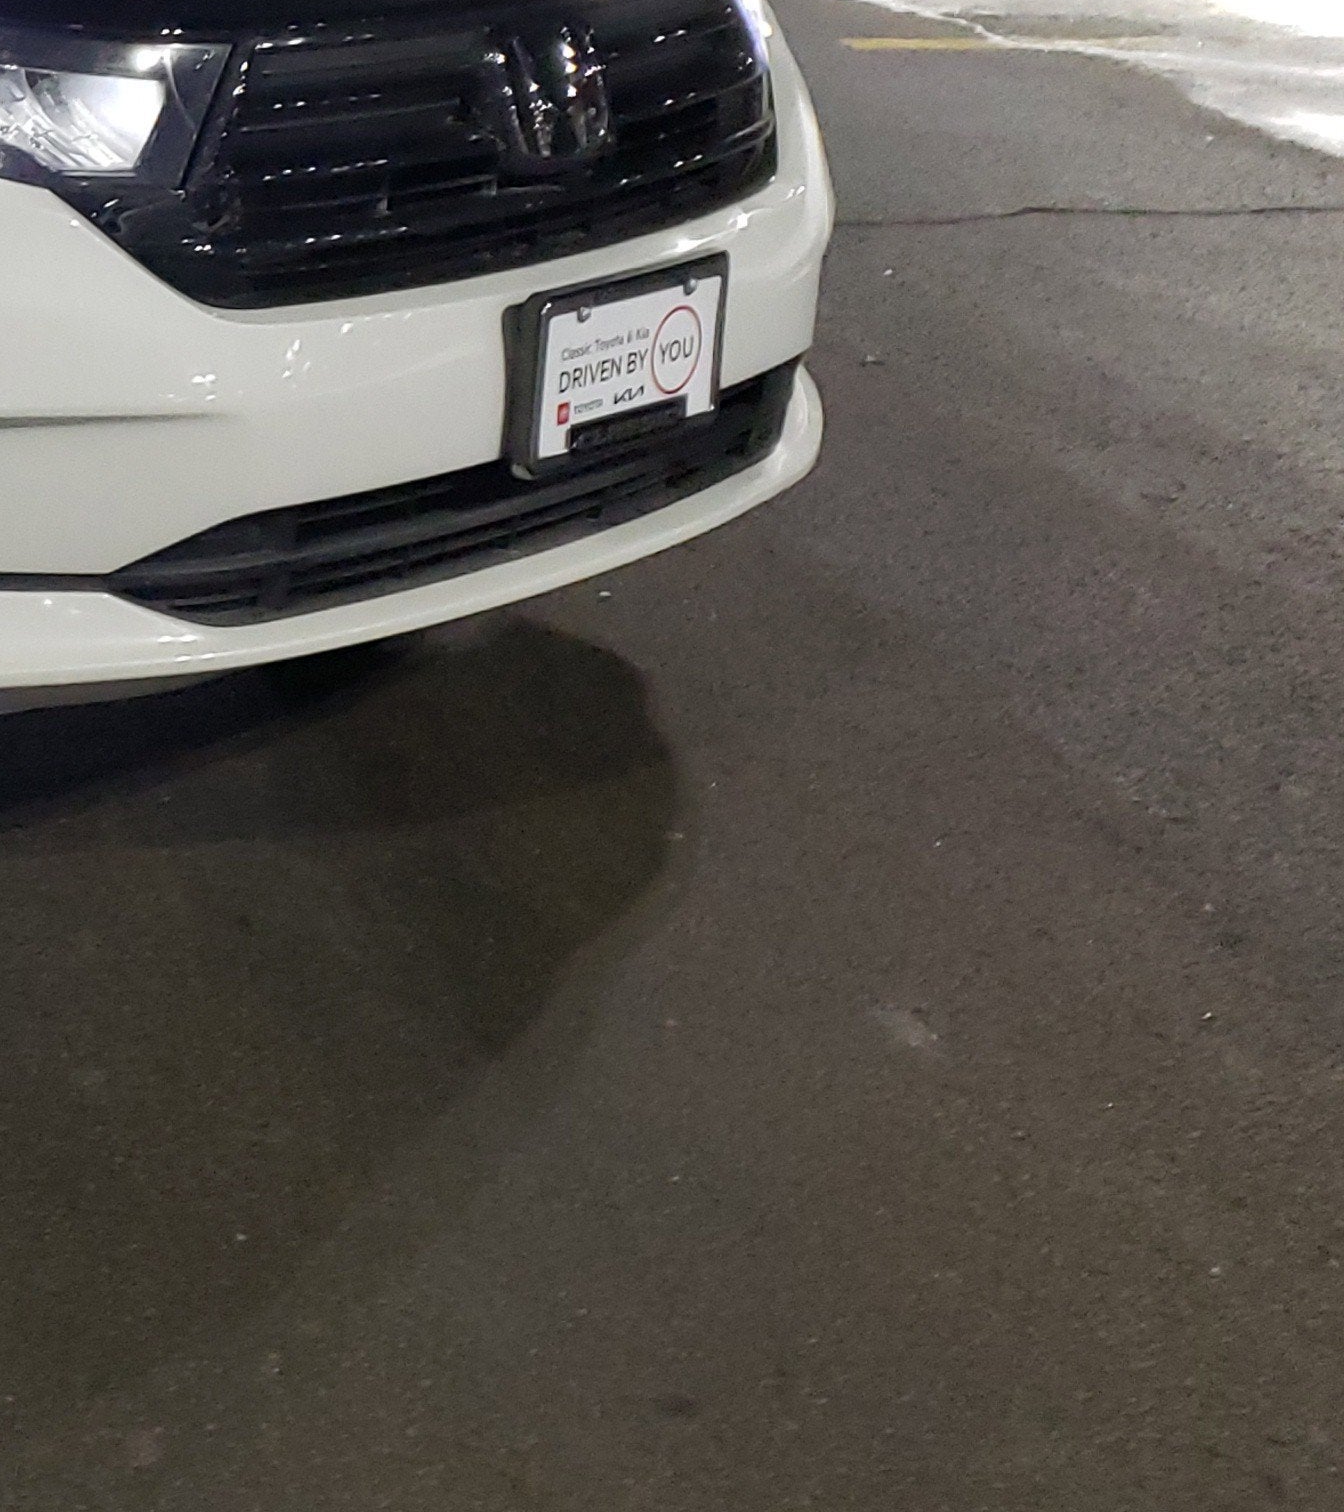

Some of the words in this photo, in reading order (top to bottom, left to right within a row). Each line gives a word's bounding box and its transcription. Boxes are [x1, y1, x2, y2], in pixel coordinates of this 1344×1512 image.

[659, 336, 695, 365] YOU
[558, 355, 623, 394] DRIVEN
[626, 348, 650, 374] BY
